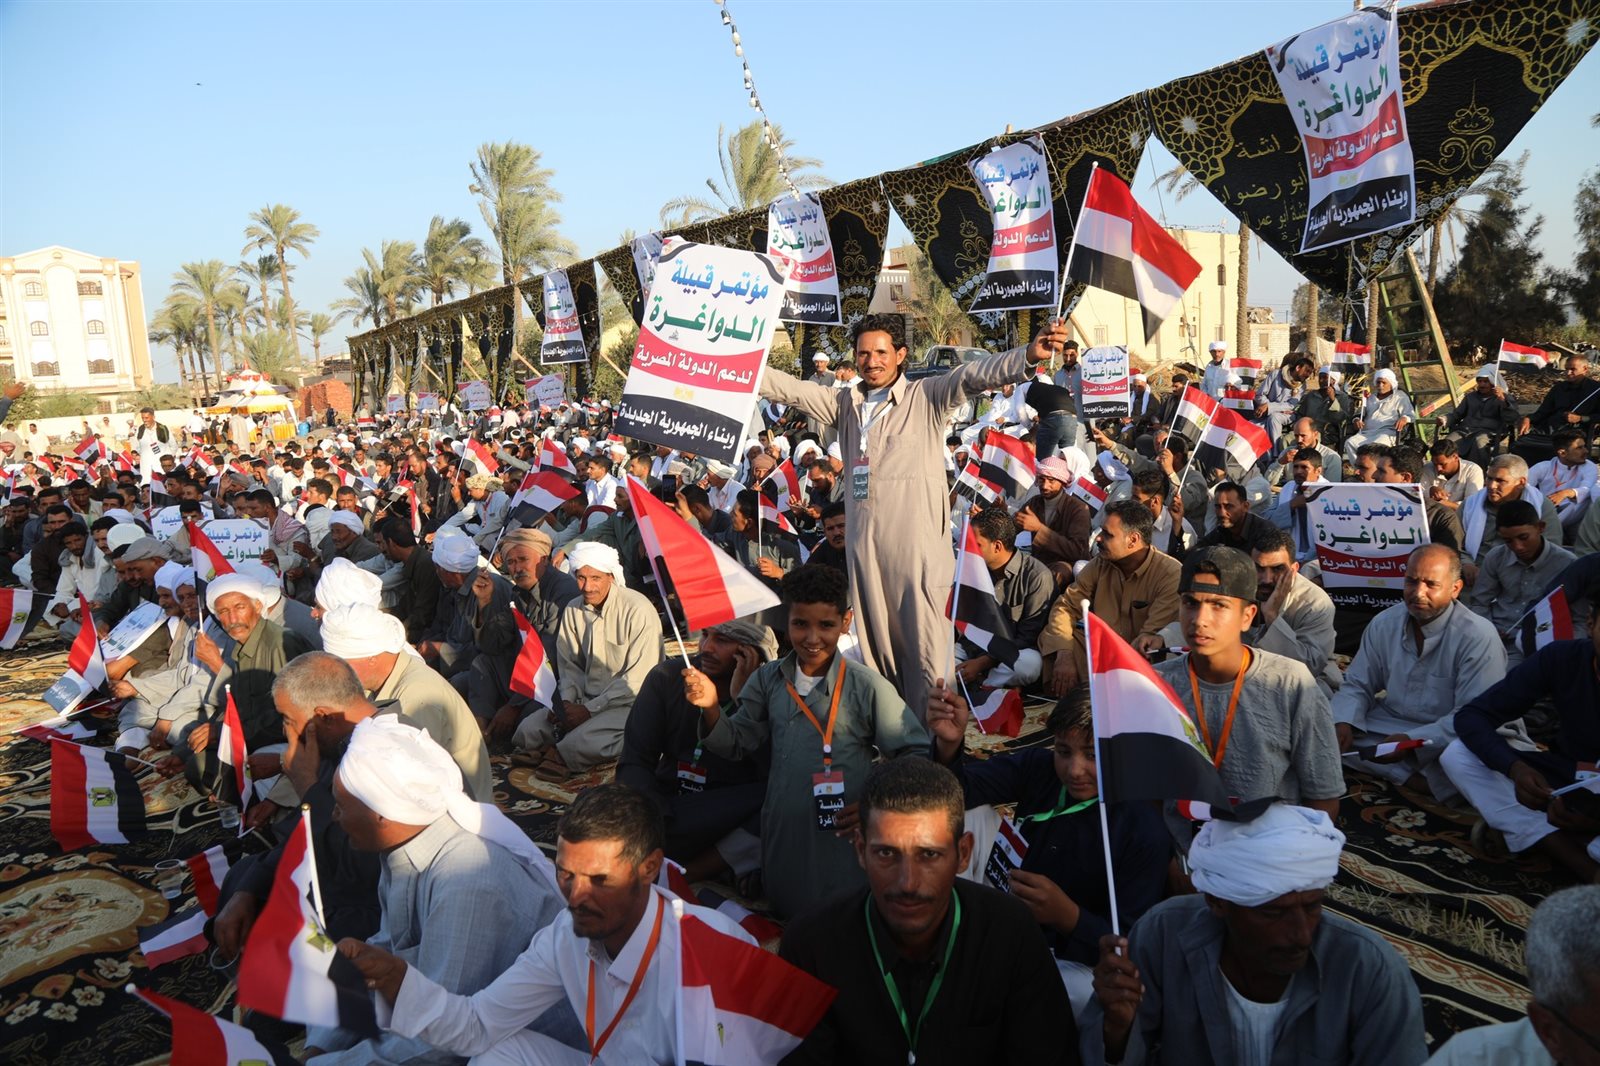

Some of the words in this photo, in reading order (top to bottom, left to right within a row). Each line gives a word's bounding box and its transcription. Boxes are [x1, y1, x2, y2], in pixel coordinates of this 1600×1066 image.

[1334, 25, 1386, 73] مؤتمر
[1287, 43, 1330, 84] قبيلة
[1297, 63, 1389, 133] الدواغرة
[1370, 118, 1397, 150] لدعم
[1336, 134, 1370, 160] الدولة
[1006, 156, 1039, 187] مؤتمر
[1331, 194, 1380, 227] الجمهورية
[1382, 188, 1408, 211] وبناء
[772, 229, 828, 254] الدواغرة
[994, 231, 1023, 249] الدولة
[1024, 229, 1050, 247] لدعم
[671, 259, 714, 295] قبيلة
[711, 271, 769, 304] مؤتمر
[1030, 279, 1052, 296] وبناء
[994, 280, 1029, 299] الجمهورية
[649, 295, 766, 343] الدواغرة
[636, 344, 676, 367] المصرية
[677, 352, 718, 376] الدولة
[717, 368, 753, 384] لدعم
[1083, 366, 1126, 380] الدواغرة
[619, 402, 659, 427] الجديدة
[658, 410, 708, 440] الجمهورية
[707, 423, 736, 450] وبناء
[1320, 498, 1361, 521] قبيلة
[1365, 500, 1413, 521] مؤتمر
[233, 527, 262, 543] مؤتمر
[1315, 525, 1423, 550] الدواغرة
[1320, 555, 1359, 570] المصرية
[1360, 558, 1396, 572] الدولة
[819, 798, 845, 812] قبيلة
